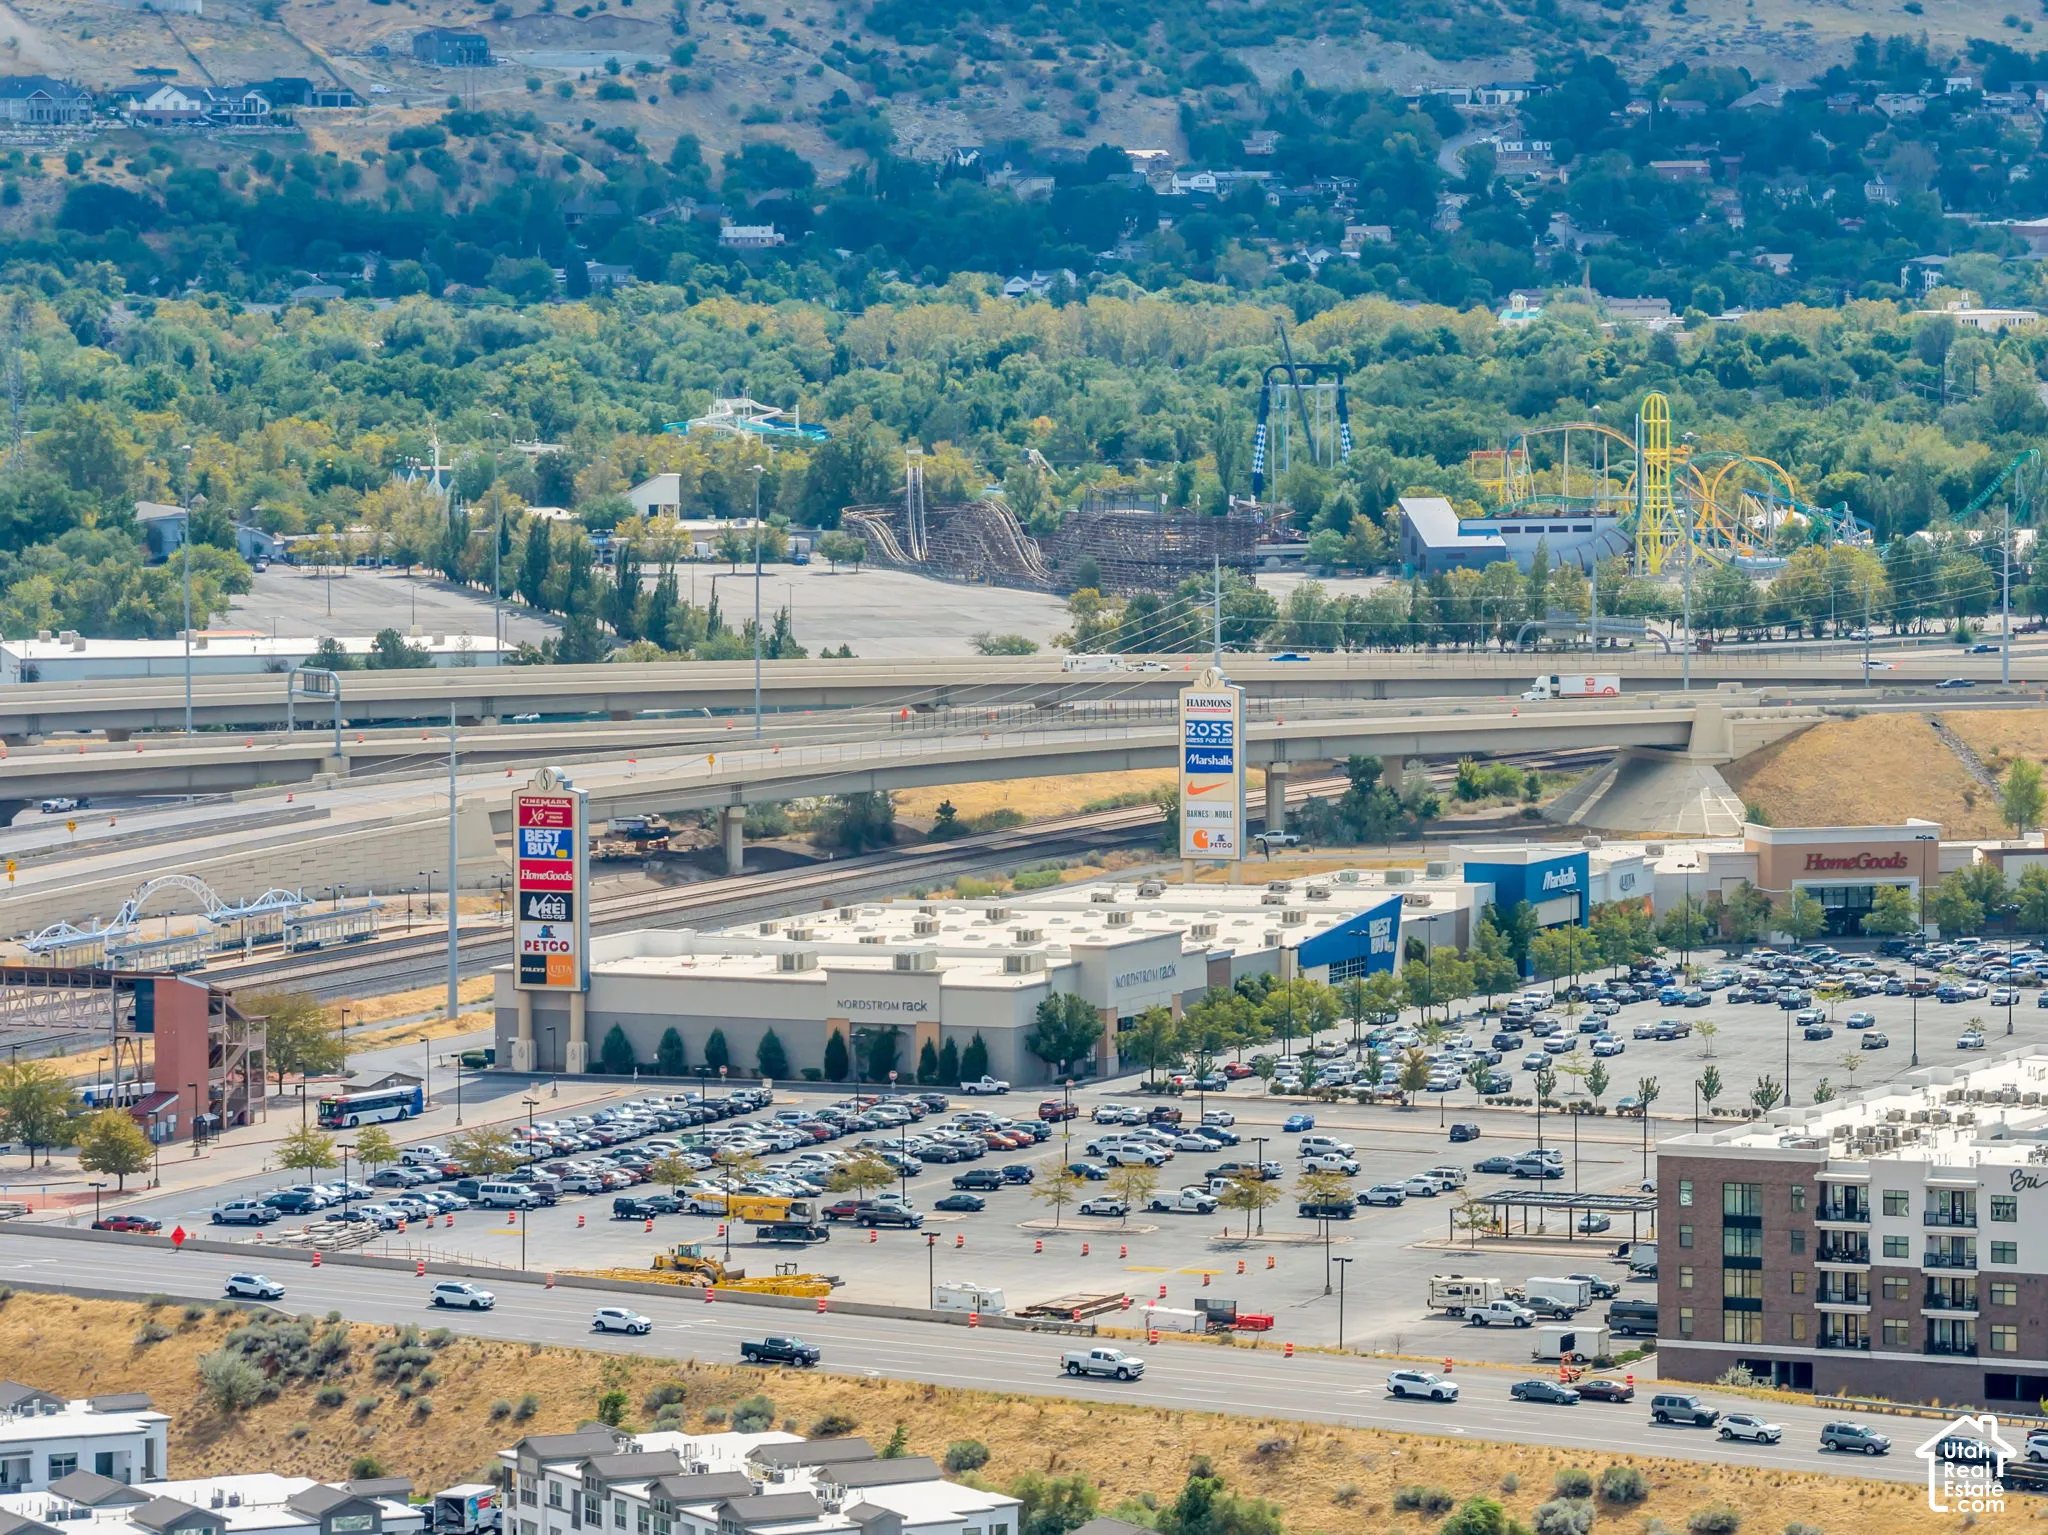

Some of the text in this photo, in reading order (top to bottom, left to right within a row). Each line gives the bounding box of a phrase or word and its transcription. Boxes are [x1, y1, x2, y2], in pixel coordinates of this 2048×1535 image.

[1186, 699, 1232, 708] HARMONS
[1186, 722, 1233, 737] ROSS
[1187, 753, 1233, 766] Marshalls
[520, 798, 571, 807] CINEMARK
[1187, 809, 1209, 818] BARNES
[1214, 810, 1233, 819] NOBLE
[525, 829, 562, 843] BEST
[528, 842, 559, 856] BUY
[1804, 851, 1908, 871] HomeGoods
[521, 869, 573, 881] HomeGoods
[1542, 866, 1577, 891] Marshalls
[541, 903, 567, 915] REI
[524, 940, 570, 953] PETCO
[1115, 960, 1177, 989] NORDSTROM rack
[837, 999, 928, 1012] NORDSTROM rack
[2009, 1168, 2048, 1192] Bri
